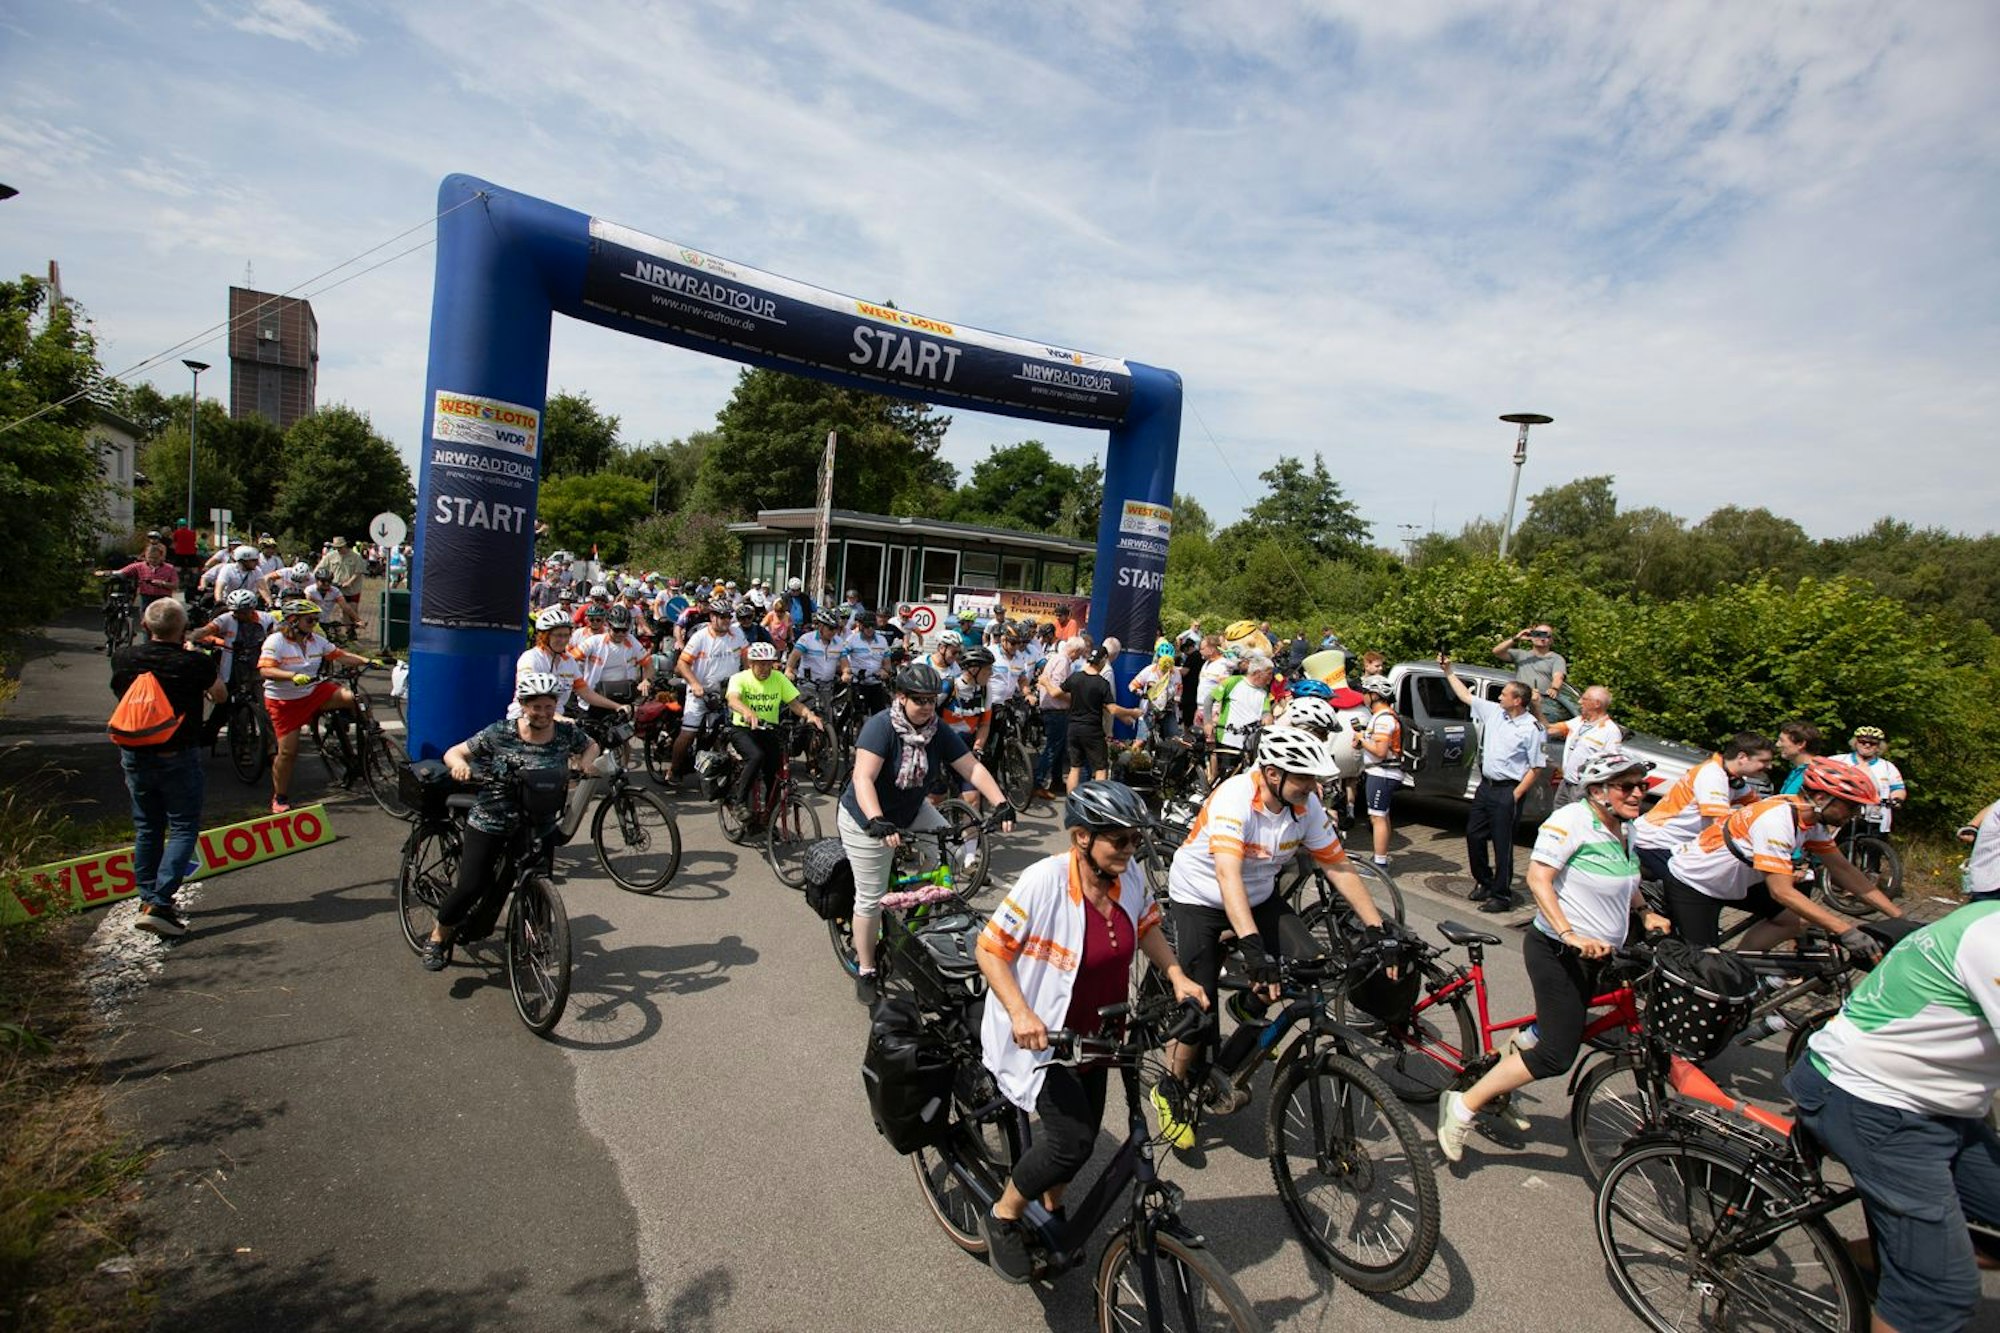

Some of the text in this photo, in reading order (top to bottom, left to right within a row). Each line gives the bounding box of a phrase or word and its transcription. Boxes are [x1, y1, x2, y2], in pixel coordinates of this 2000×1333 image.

[634, 260, 776, 318] NRWRADTOUR
[651, 293, 756, 332] www.nrw-radtour.de
[858, 303, 953, 335] WEST LOTTO
[849, 325, 963, 384] START
[1021, 362, 1112, 391] NRWRADTOUR
[440, 398, 537, 429] WEST LOTTO
[495, 429, 526, 447] WDR
[434, 449, 534, 479] NRWRADTOUR
[434, 494, 527, 535] START
[915, 614, 930, 627] 20
[745, 691, 779, 701] Radtour
[751, 703, 773, 713] NRW
[200, 811, 322, 870] LOTTO
